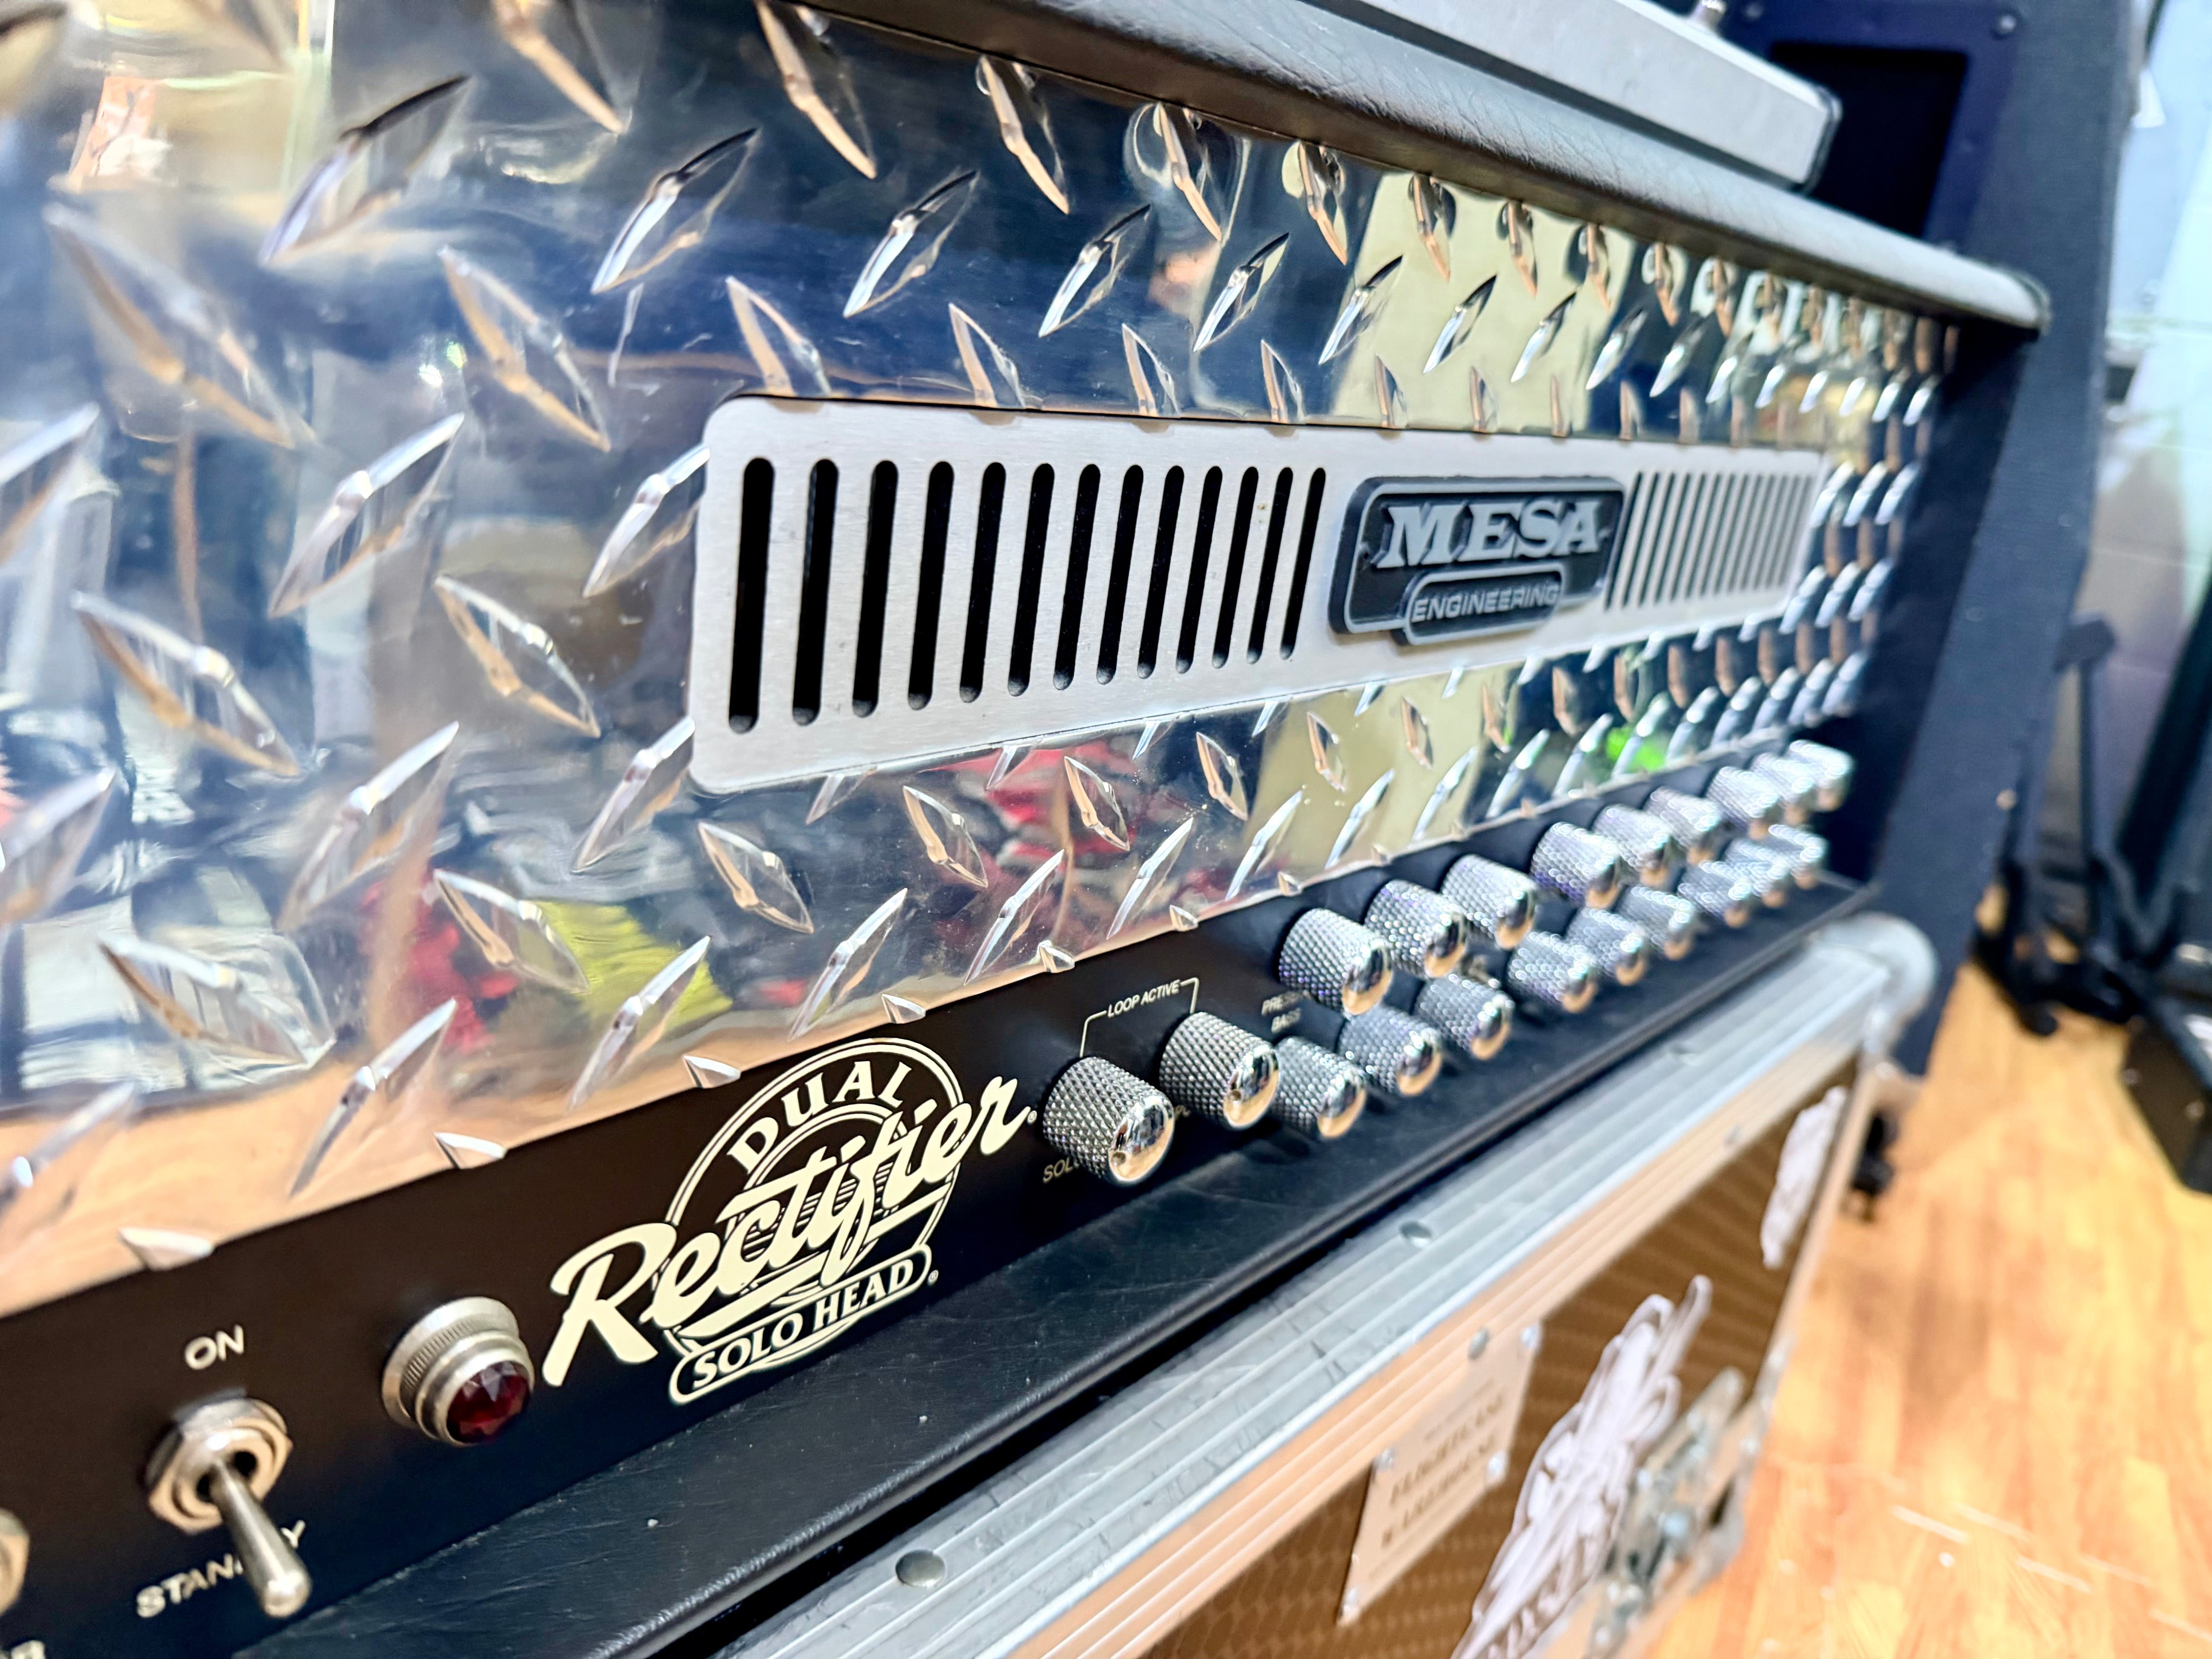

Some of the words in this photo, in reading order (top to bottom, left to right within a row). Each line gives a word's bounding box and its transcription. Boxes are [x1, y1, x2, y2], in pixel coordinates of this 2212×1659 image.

[1371, 498, 1604, 568] MESA
[1411, 580, 1560, 623] ENGINEERING
[1108, 994, 1140, 1018] LOOP
[1140, 979, 1181, 1006] ACTIVE
[726, 1060, 912, 1175] DUAL
[1042, 1156, 1074, 1183] SOL
[184, 1325, 245, 1370] ON
[692, 1312, 804, 1389] SOLO
[813, 1259, 914, 1331] HEAD
[136, 1520, 306, 1618] STANY
